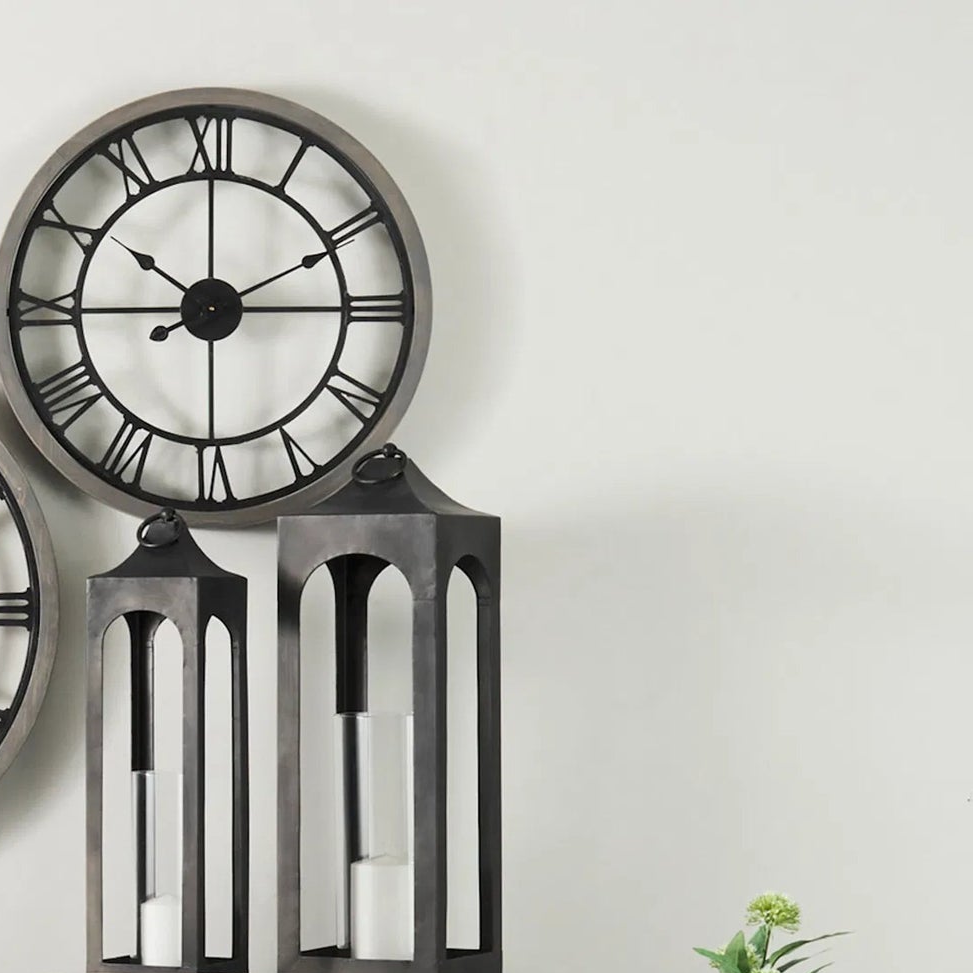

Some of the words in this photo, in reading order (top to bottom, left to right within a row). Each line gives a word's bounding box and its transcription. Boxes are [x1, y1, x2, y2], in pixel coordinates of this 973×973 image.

[94, 134, 160, 199] XI
[183, 115, 237, 176] XII
[32, 201, 101, 256] X
[323, 202, 388, 251] II
[17, 288, 78, 331] IX
[345, 292, 407, 327] III
[196, 443, 237, 503] VI
[279, 426, 323, 483] V
